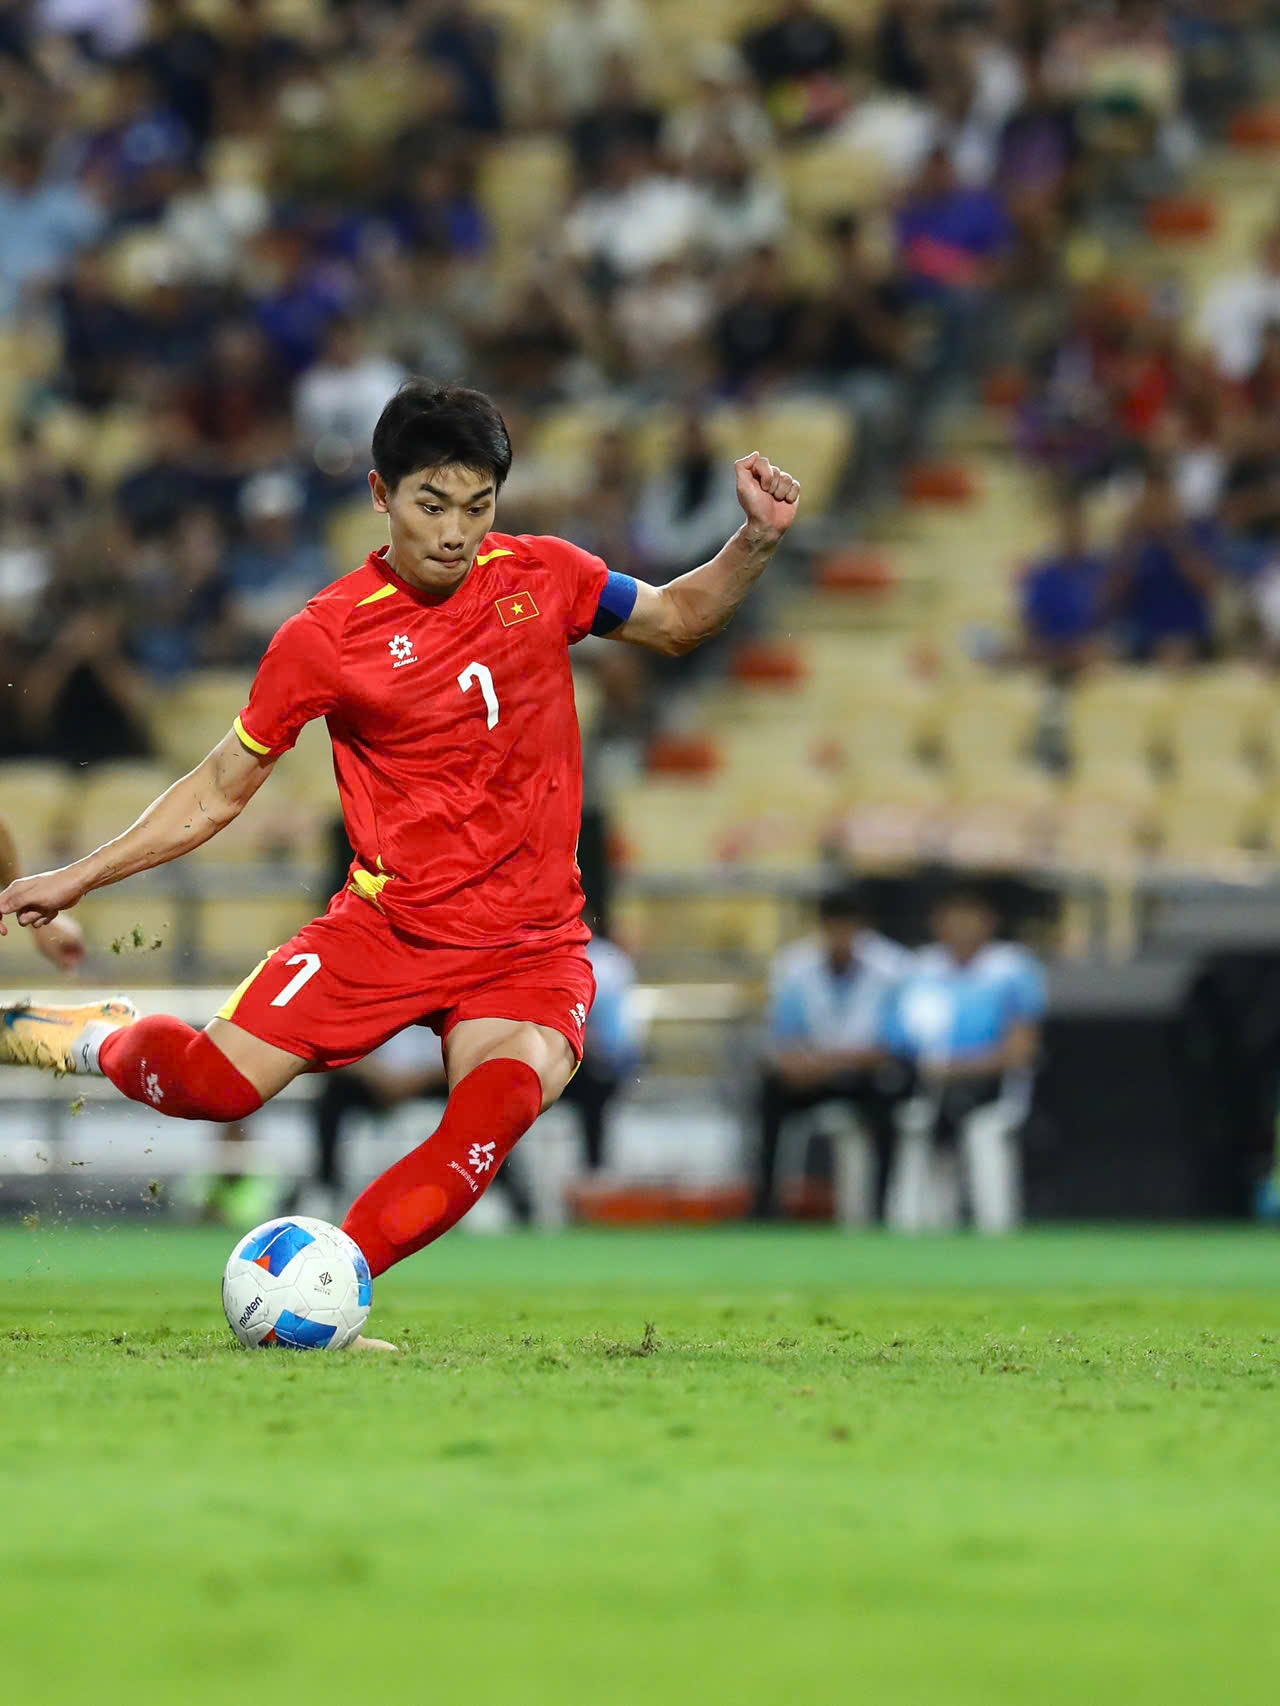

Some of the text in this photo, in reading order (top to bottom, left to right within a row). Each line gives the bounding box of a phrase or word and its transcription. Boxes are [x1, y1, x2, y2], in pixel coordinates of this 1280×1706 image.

[457, 661, 500, 731] 7
[270, 953, 322, 1007] 7
[239, 1296, 263, 1328] molten
